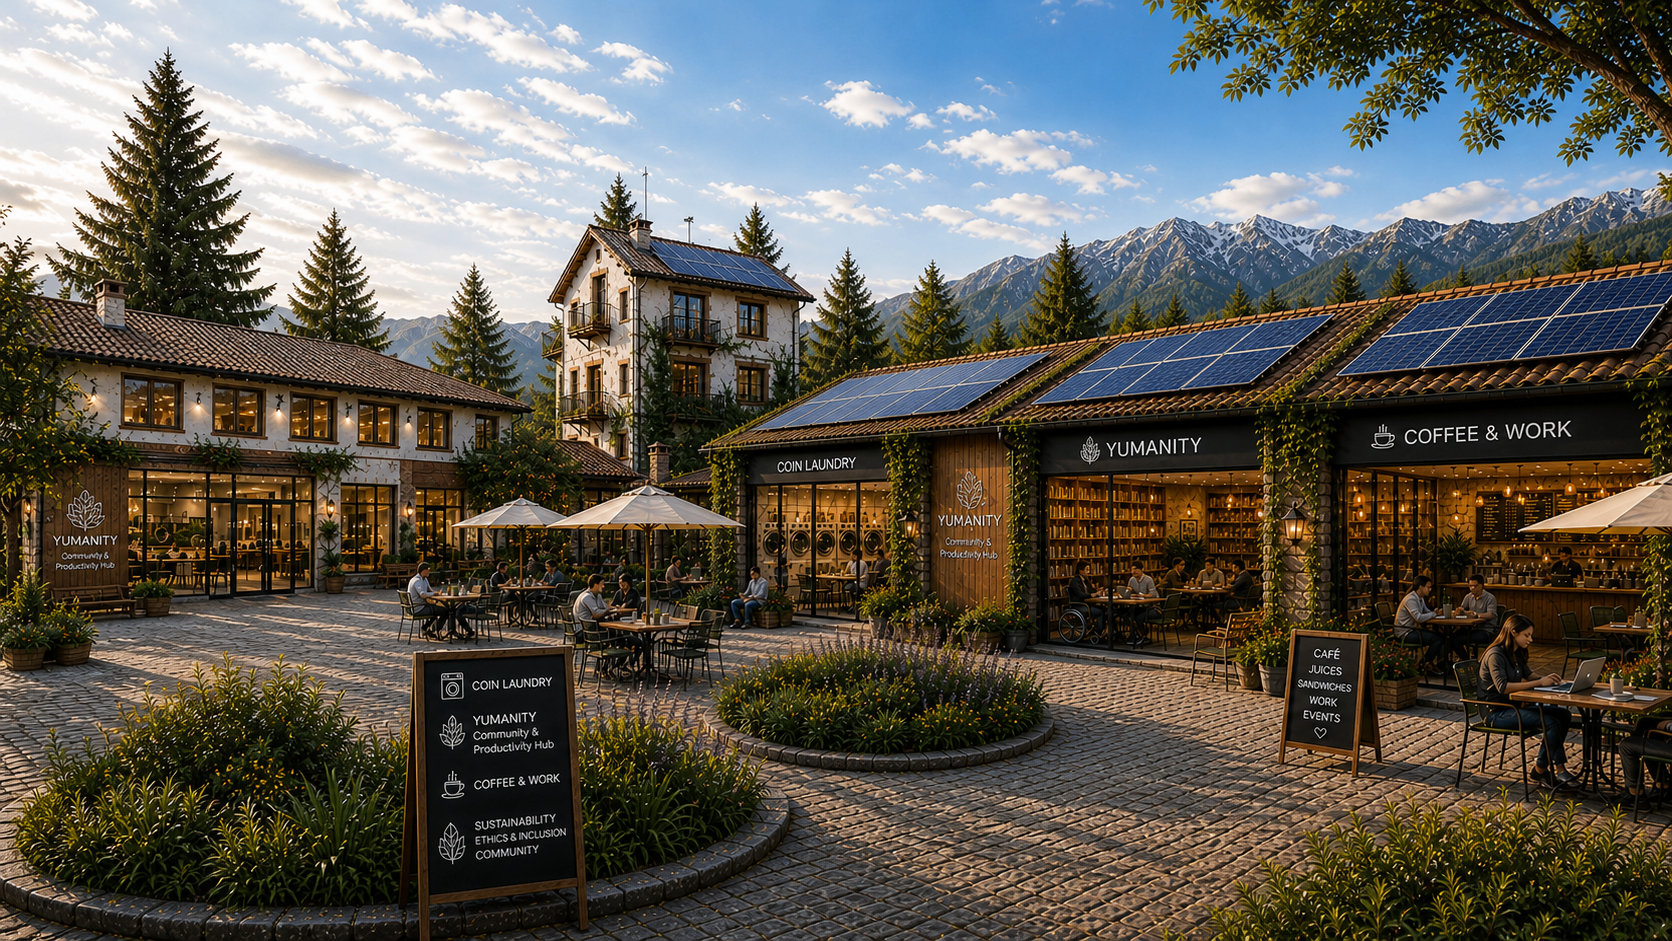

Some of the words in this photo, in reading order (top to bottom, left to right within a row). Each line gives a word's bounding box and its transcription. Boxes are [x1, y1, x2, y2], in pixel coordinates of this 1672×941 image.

[1403, 425, 1479, 446] COFFEE
[1485, 424, 1499, 441] &
[1504, 420, 1573, 440] WORK
[1106, 437, 1203, 457] YUMANITY
[777, 460, 803, 473] COIN
[805, 457, 857, 471] LAUNDRY
[937, 514, 1003, 527] YUMANITY
[52, 534, 119, 547] YUMANITY
[982, 550, 999, 560] Hub
[100, 561, 116, 569] Hub
[1313, 647, 1341, 660] CAFÉ
[1308, 664, 1343, 677] JUICES
[471, 680, 499, 691] COIN
[502, 677, 553, 689] LAUNDRY
[1297, 678, 1353, 693] SANDWICHES
[1309, 695, 1338, 708] WORK
[472, 711, 537, 725] YUMANITY
[1302, 709, 1341, 724] EVENTS
[472, 727, 529, 740] Community
[531, 727, 539, 737] &
[473, 741, 532, 755] Productivity
[534, 740, 555, 750] Hub
[473, 776, 516, 791] COFFEE
[517, 776, 526, 787] &
[528, 773, 561, 786] WORK
[474, 813, 556, 831] SUSTAINABILITY
[474, 833, 509, 846] ETHICS
[509, 833, 517, 842] &
[518, 827, 567, 842] INCLUSION
[475, 844, 540, 861] COMMUNITY
